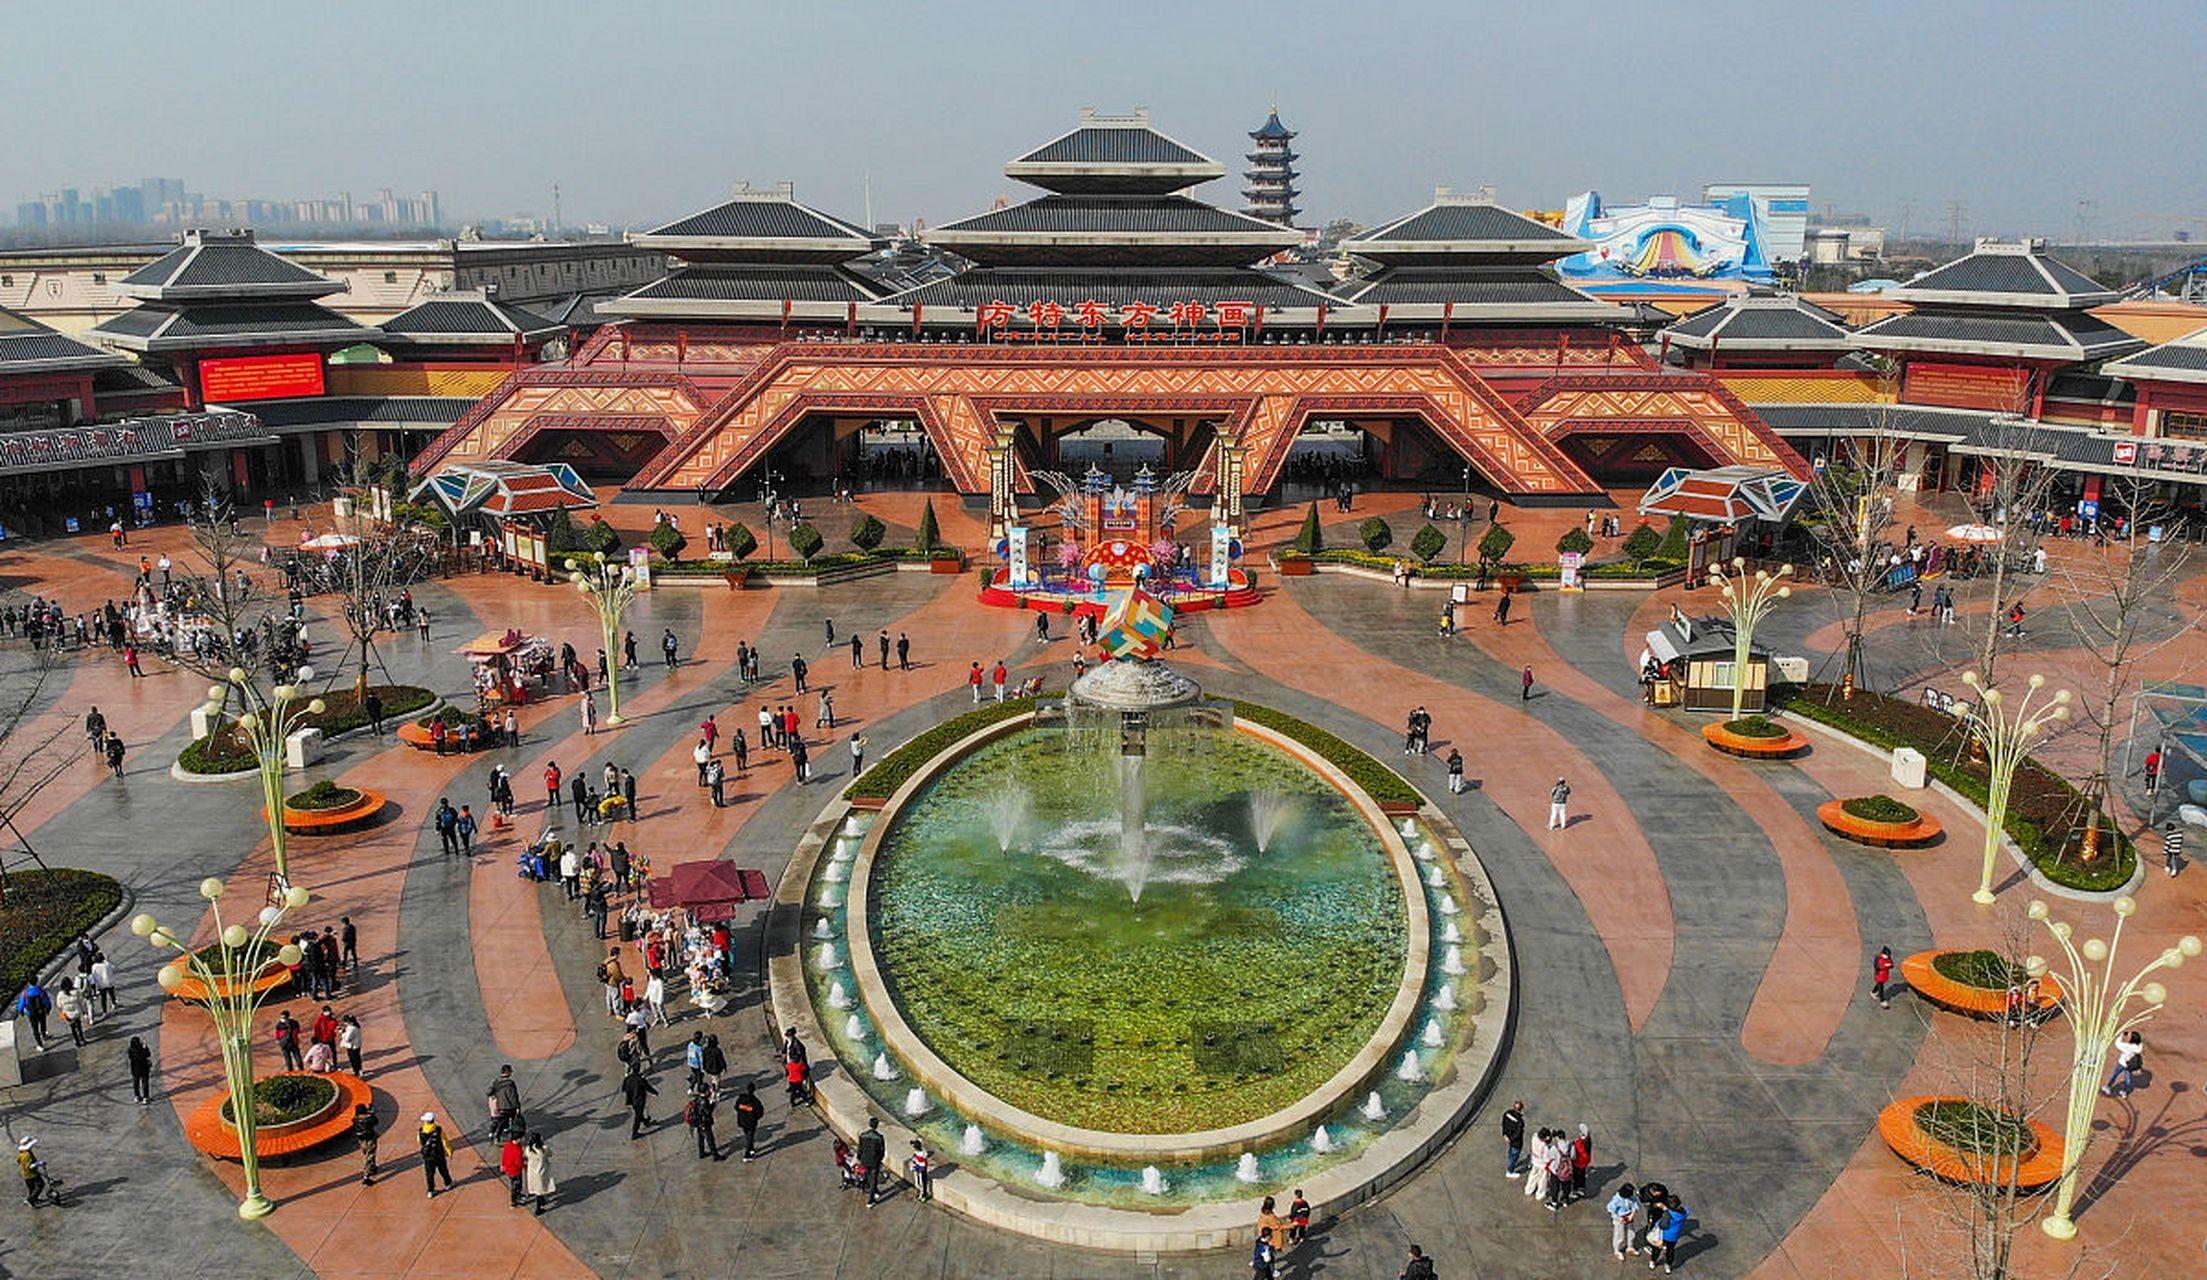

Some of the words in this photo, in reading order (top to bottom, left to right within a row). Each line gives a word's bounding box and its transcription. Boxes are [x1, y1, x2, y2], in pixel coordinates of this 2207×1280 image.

[984, 300, 1253, 327] 方特东方神画
